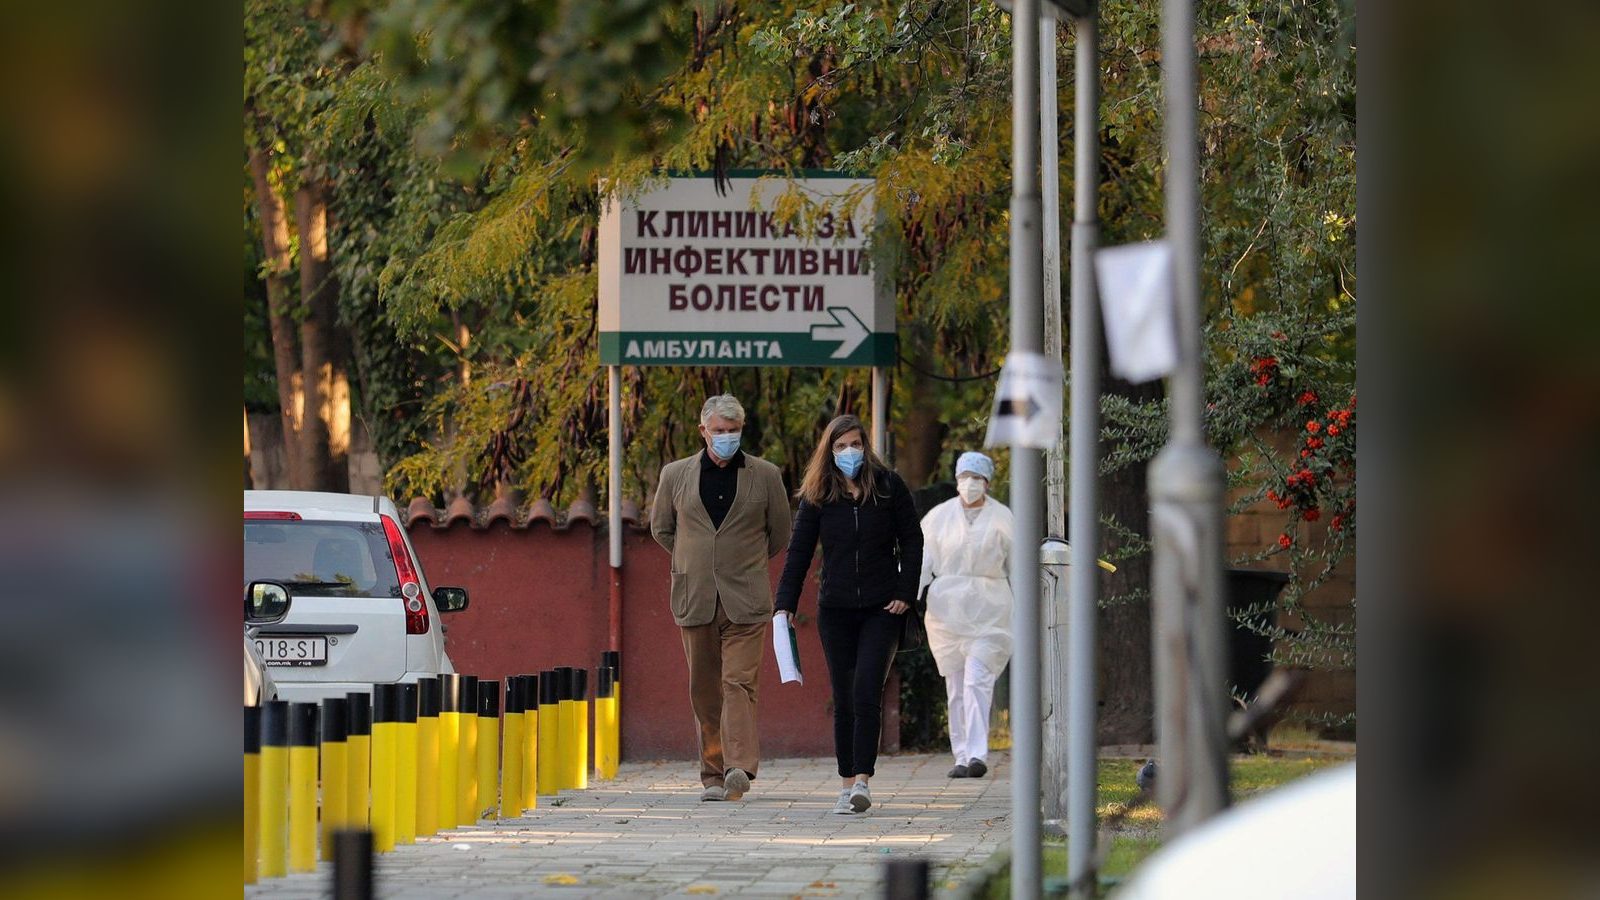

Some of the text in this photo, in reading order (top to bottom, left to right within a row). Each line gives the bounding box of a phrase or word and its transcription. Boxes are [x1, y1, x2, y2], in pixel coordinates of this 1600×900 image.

[624, 245, 870, 277] ИНФЕКТИВНИ
[668, 284, 824, 312] БОЛЕСТИ
[625, 340, 783, 359] АМБУЛАНТА
